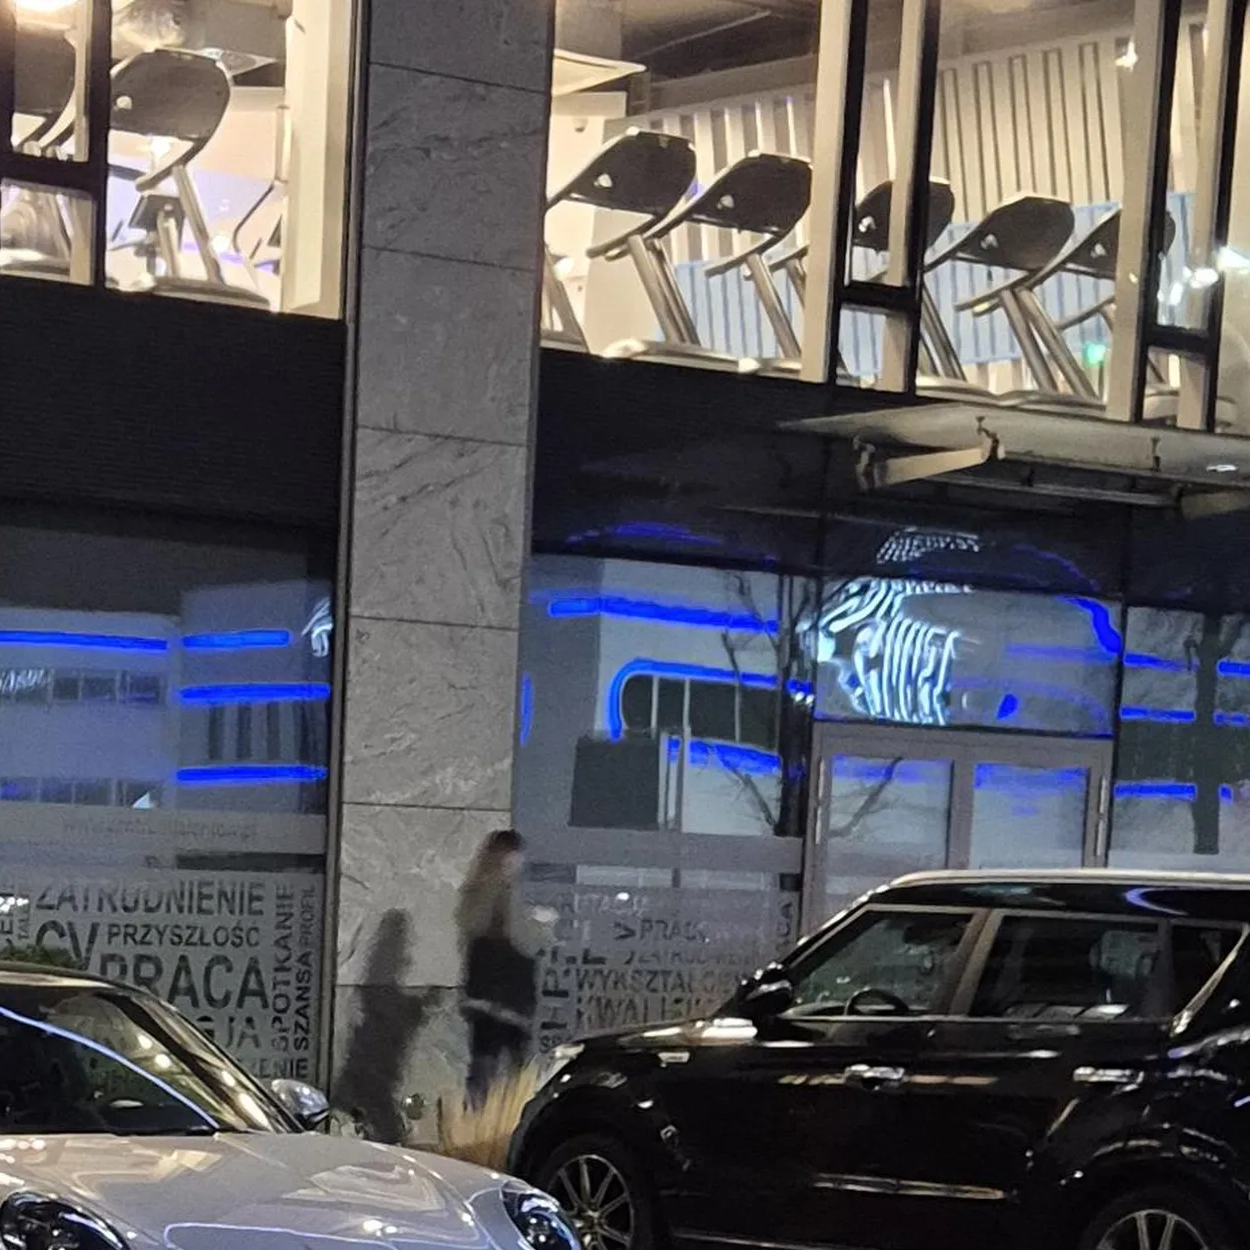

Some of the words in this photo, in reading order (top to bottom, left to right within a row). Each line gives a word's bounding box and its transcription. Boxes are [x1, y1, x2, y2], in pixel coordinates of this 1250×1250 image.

[35, 878, 265, 917] ZATRUDNIENIE
[100, 952, 270, 1010] PRACA
[293, 951, 316, 1052] SZANSA
